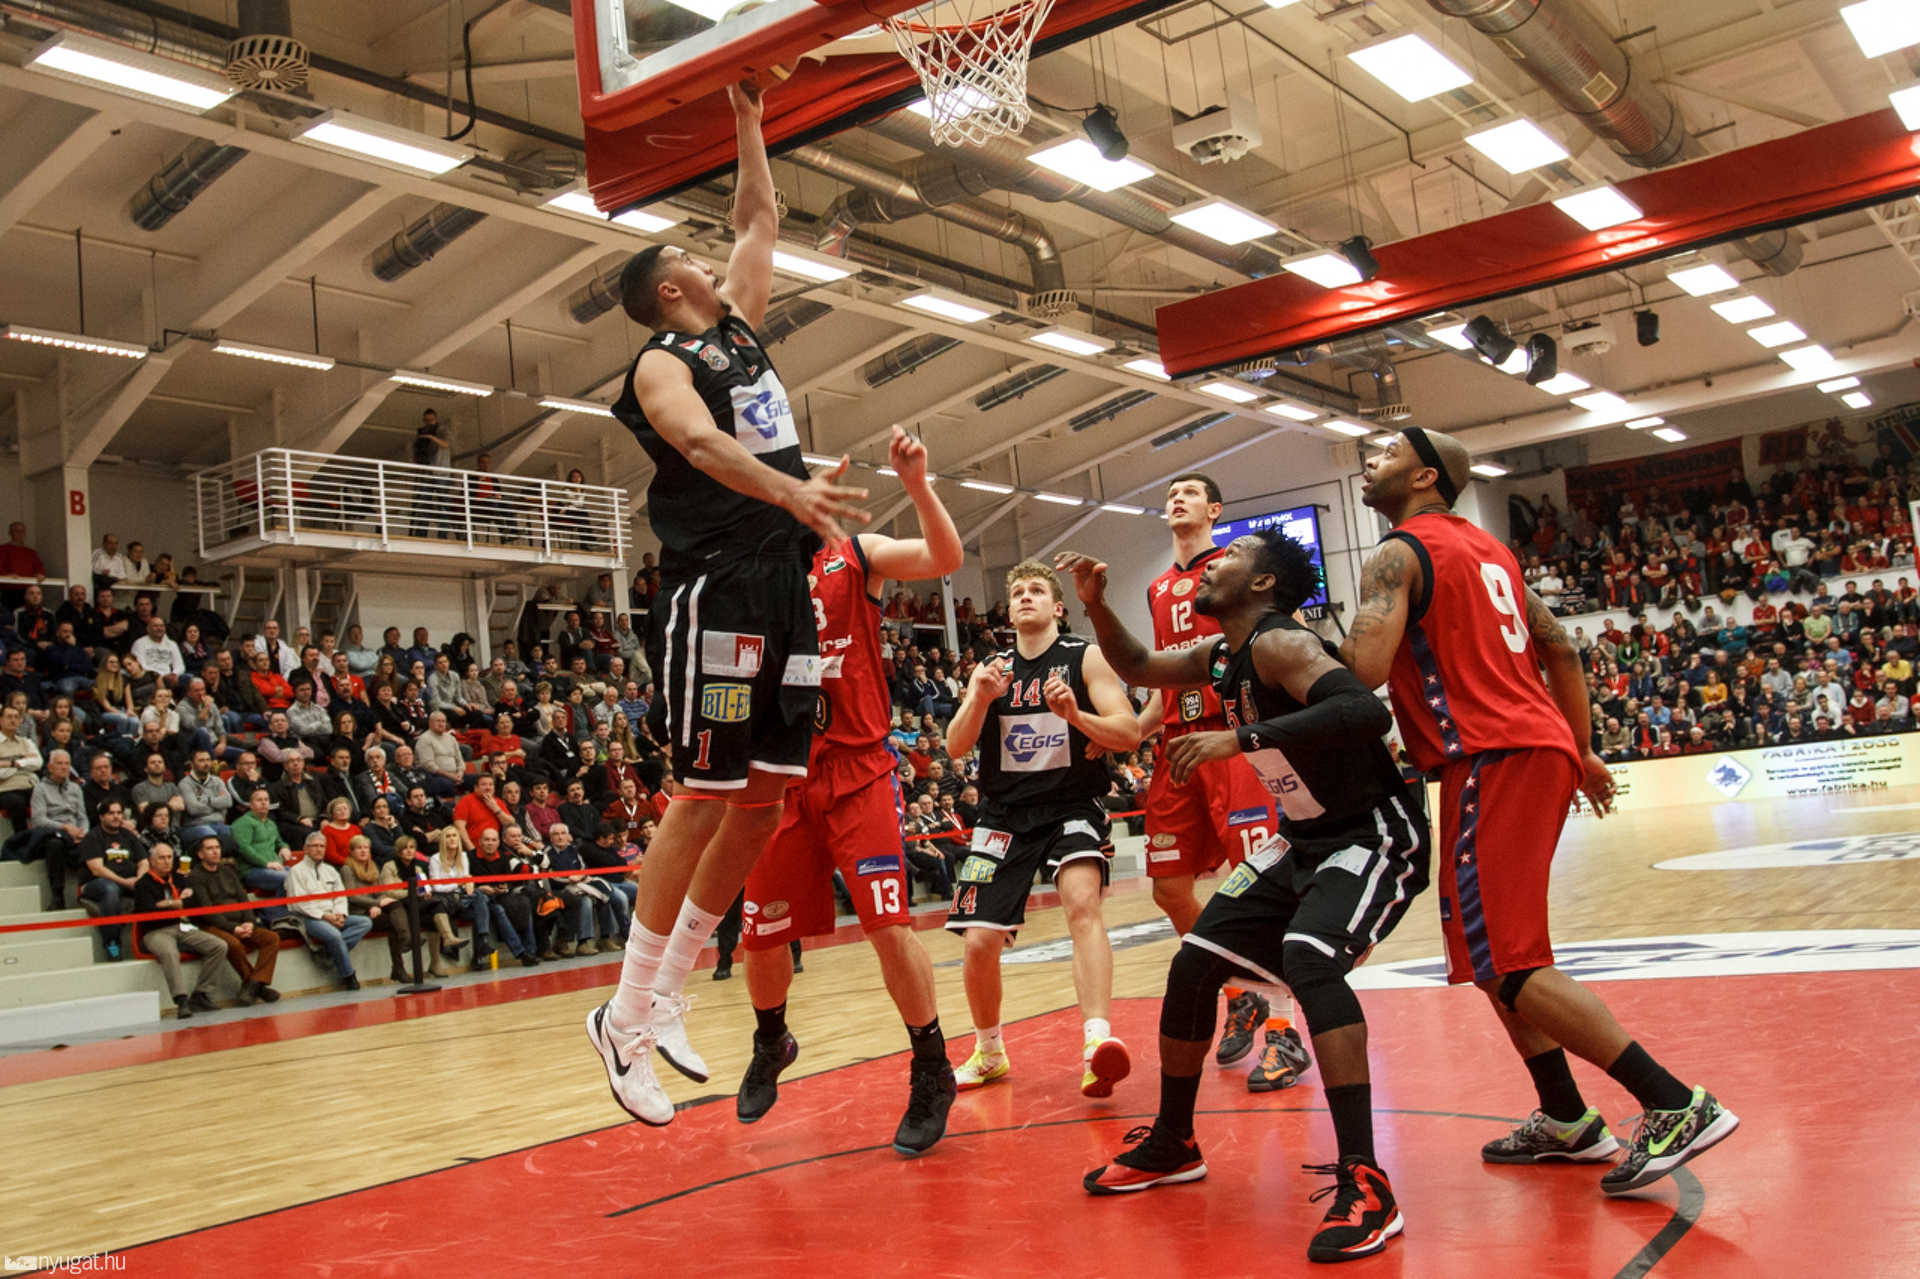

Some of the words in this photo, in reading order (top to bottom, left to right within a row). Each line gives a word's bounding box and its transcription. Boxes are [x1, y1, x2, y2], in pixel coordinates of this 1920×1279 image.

[70, 491, 86, 515] B
[1171, 600, 1193, 633] 12
[1480, 562, 1529, 654] 9
[1011, 678, 1041, 708] 14
[693, 729, 712, 770] 1
[1019, 732, 1066, 750] EGIS
[1787, 780, 1888, 796] www.fabrika.hu
[870, 878, 901, 916] 13
[949, 885, 978, 915] 14
